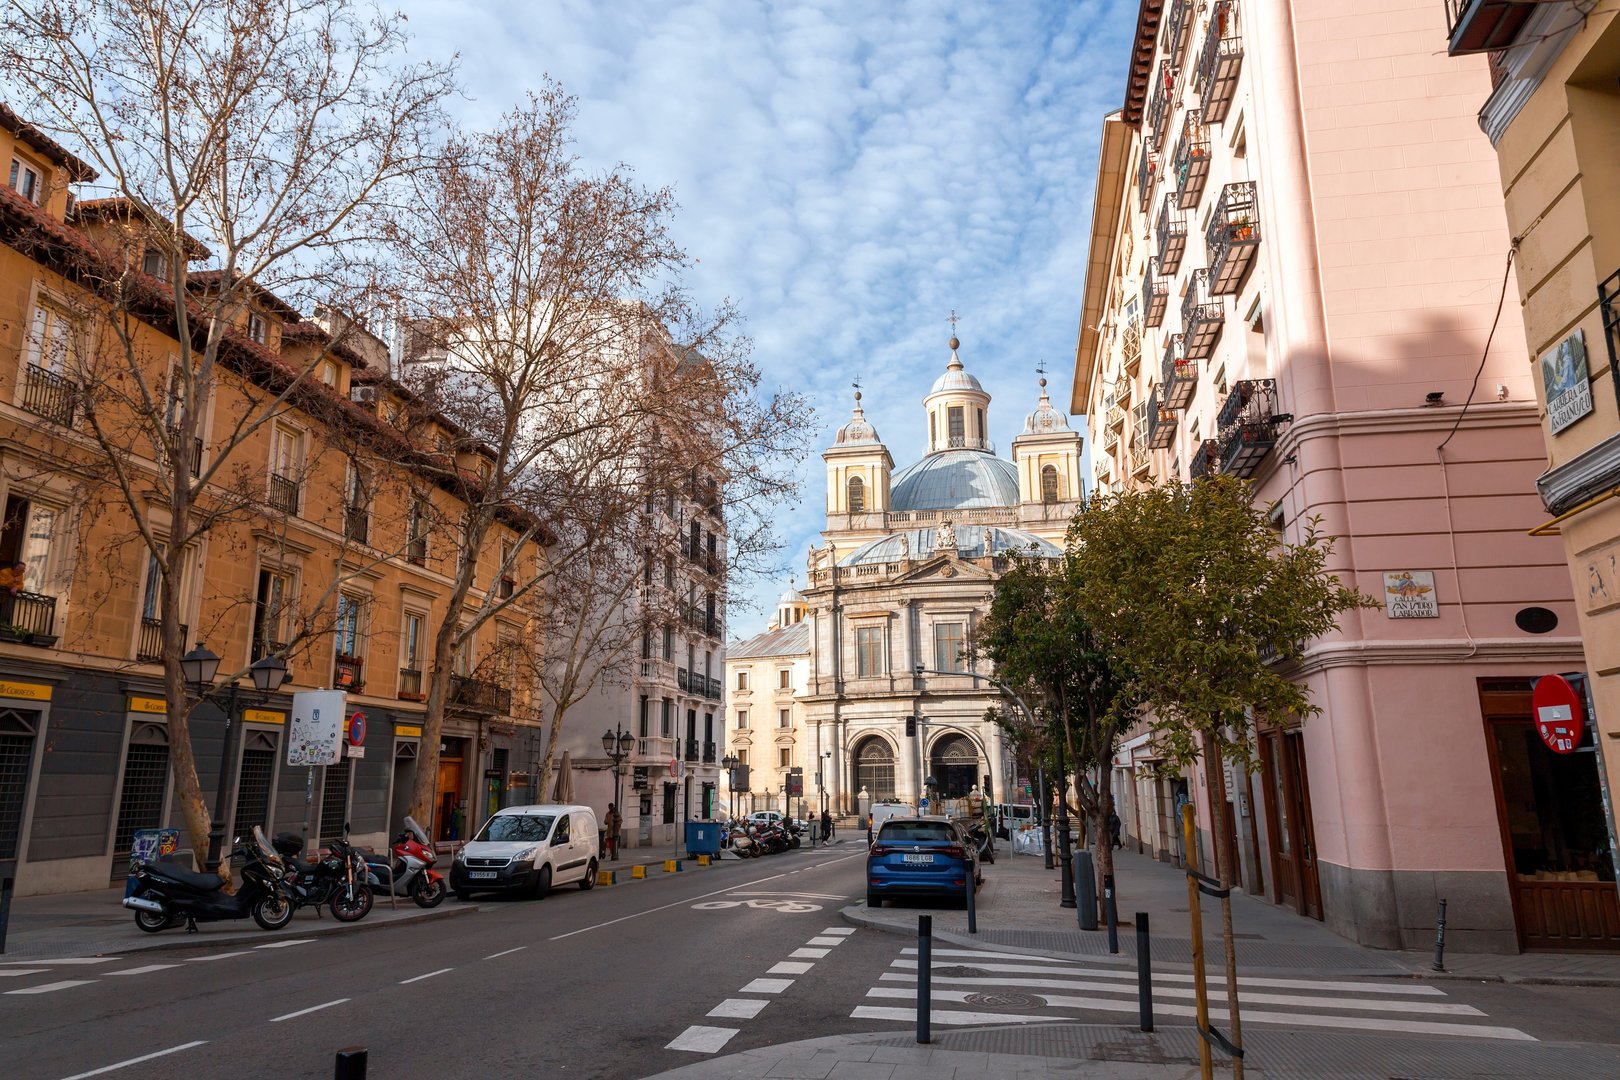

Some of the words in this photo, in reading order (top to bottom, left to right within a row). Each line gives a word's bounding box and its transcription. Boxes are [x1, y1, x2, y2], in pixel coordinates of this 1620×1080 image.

[1549, 389, 1578, 415] CARRERA
[1578, 381, 1588, 394] DE
[1392, 602, 1408, 610] SAN
